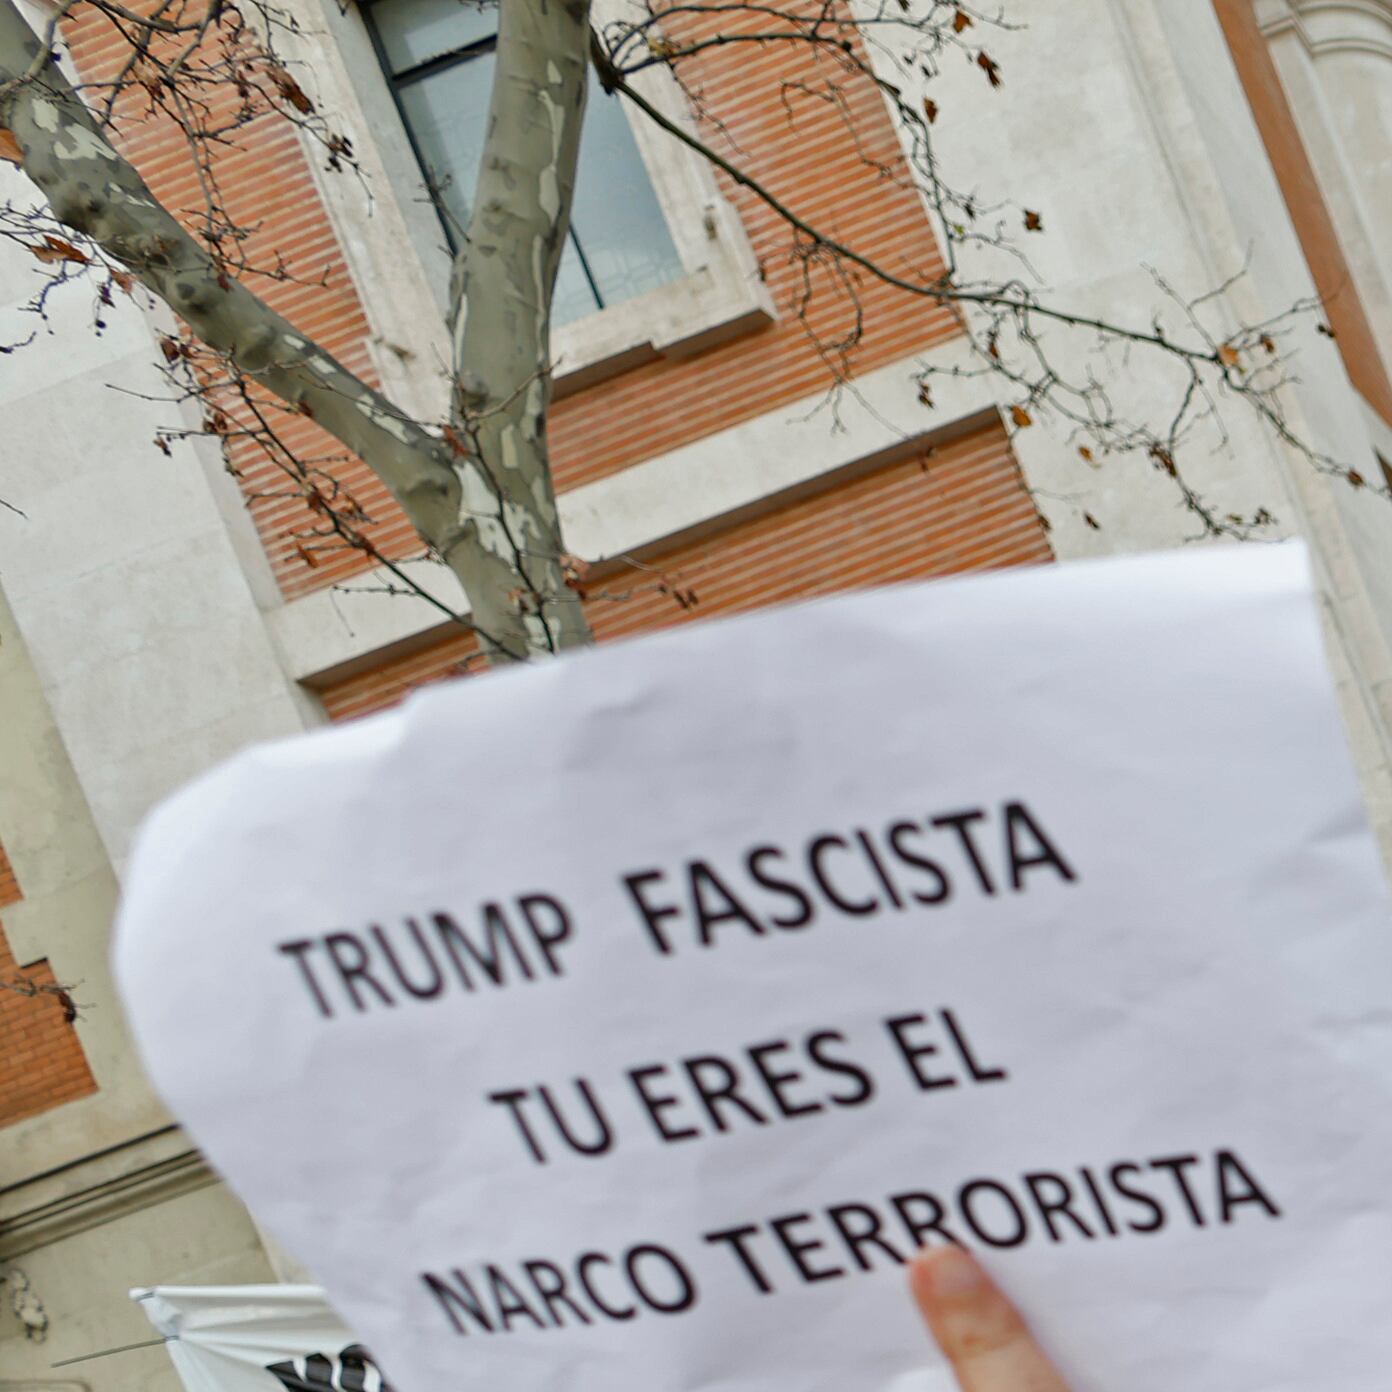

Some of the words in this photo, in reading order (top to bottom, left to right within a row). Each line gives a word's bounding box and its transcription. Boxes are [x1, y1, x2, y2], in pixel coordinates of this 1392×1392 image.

[278, 891, 575, 1020] TRUMP
[622, 799, 1078, 954] FASCISTA
[488, 1078, 616, 1165] TU
[627, 1028, 874, 1145] ERES
[885, 1009, 1007, 1091] EL
[421, 1241, 695, 1337] NARCO
[705, 1147, 1282, 1295] TERRORISTA
